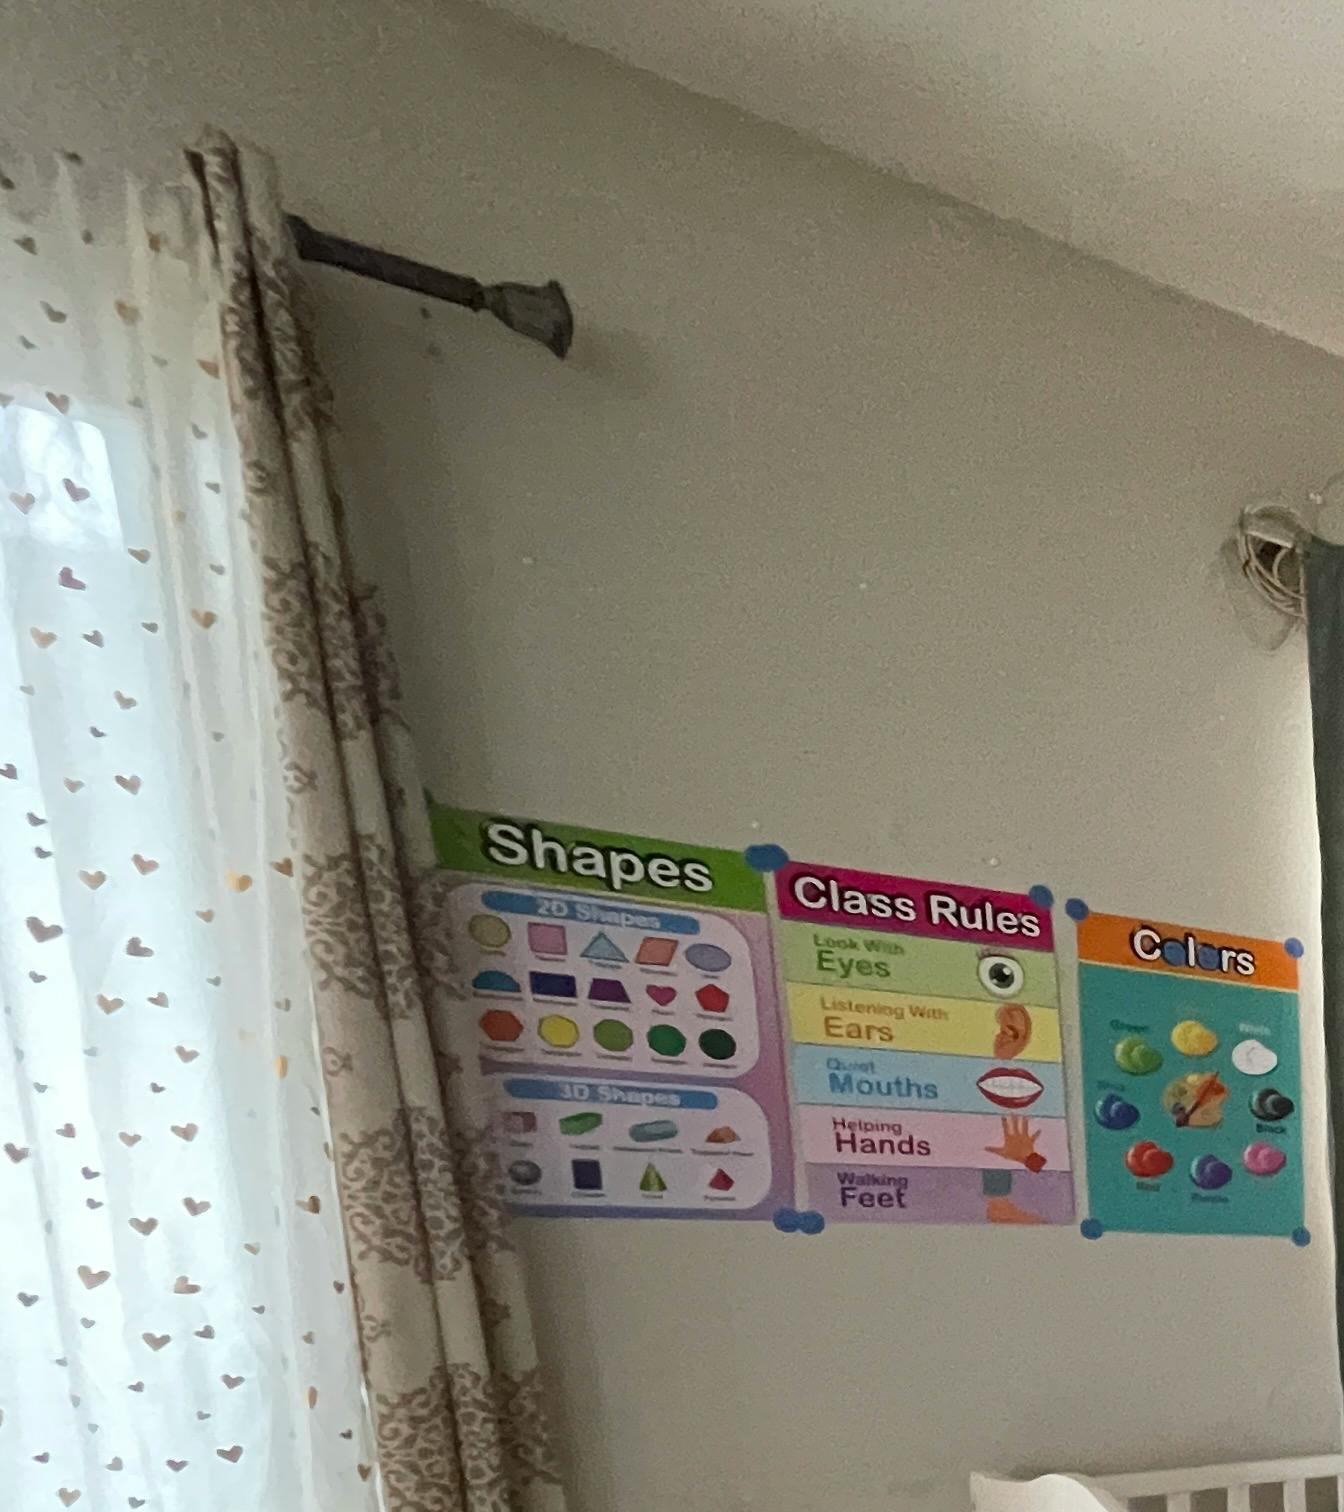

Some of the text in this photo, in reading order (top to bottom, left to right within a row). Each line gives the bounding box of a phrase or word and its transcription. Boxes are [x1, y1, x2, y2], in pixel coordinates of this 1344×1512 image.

[485, 821, 714, 892] Shapes
[537, 899, 661, 929] 2D Shapes
[793, 876, 1042, 938] Class Rules
[814, 934, 905, 955] Look With
[817, 950, 891, 978] Eyes
[821, 997, 949, 1021] Listening With
[824, 1016, 894, 1042] Ears
[827, 1057, 875, 1074] Quiet
[559, 1083, 682, 1107] 3D Shapes
[828, 1072, 939, 1100] Mouths
[832, 1116, 903, 1136] Helping
[835, 1131, 931, 1156] Hands
[837, 1171, 908, 1189] Walking
[840, 1187, 907, 1209] Feet
